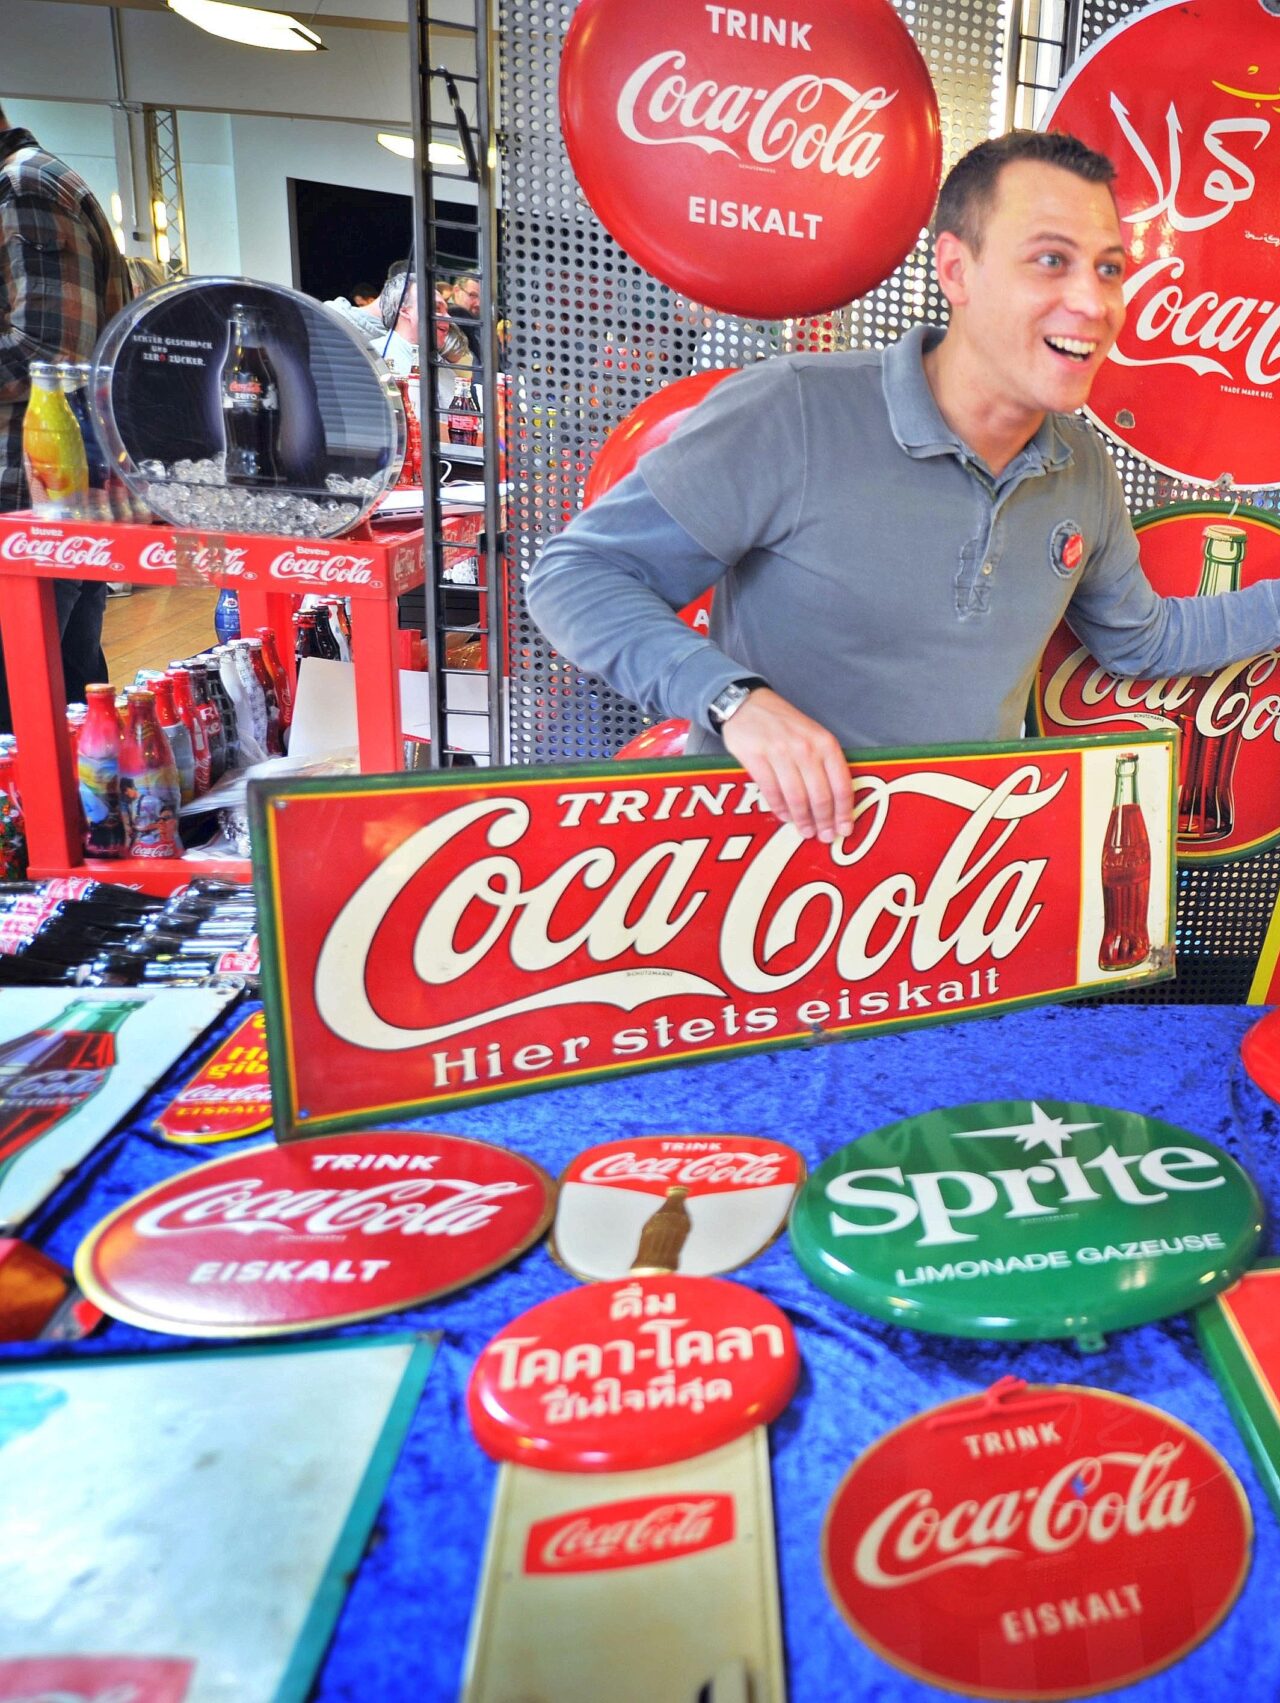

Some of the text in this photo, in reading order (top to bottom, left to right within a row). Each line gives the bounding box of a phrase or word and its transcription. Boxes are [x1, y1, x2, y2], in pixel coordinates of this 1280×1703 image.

[705, 4, 813, 51] TRINK
[616, 50, 899, 179] Coca-Cola
[688, 196, 823, 240] EISKALT
[1, 531, 115, 566] Coca-Cola
[270, 551, 375, 584] Coca-Cola
[557, 782, 771, 828] TRINK
[314, 765, 1069, 1051] Coca-Cola
[432, 966, 1001, 1088] Hier stets eiskalt
[310, 1153, 442, 1171] TRINK
[580, 1151, 789, 1185] Coca-Cola
[661, 1141, 723, 1153] TRINK
[134, 1178, 534, 1237] Coca-Cola
[825, 1144, 1226, 1247] Sprite
[187, 1259, 390, 1285] EISKALT
[896, 1233, 1227, 1287] LIMONADE GAZEUSE
[486, 1318, 785, 1391] โคคา-โคลา
[962, 1421, 1062, 1459] TRINK
[541, 1498, 719, 1567] Coca-Cola
[853, 1440, 1198, 1589] Coca-Cola
[1001, 1584, 1144, 1645] EISKALT
